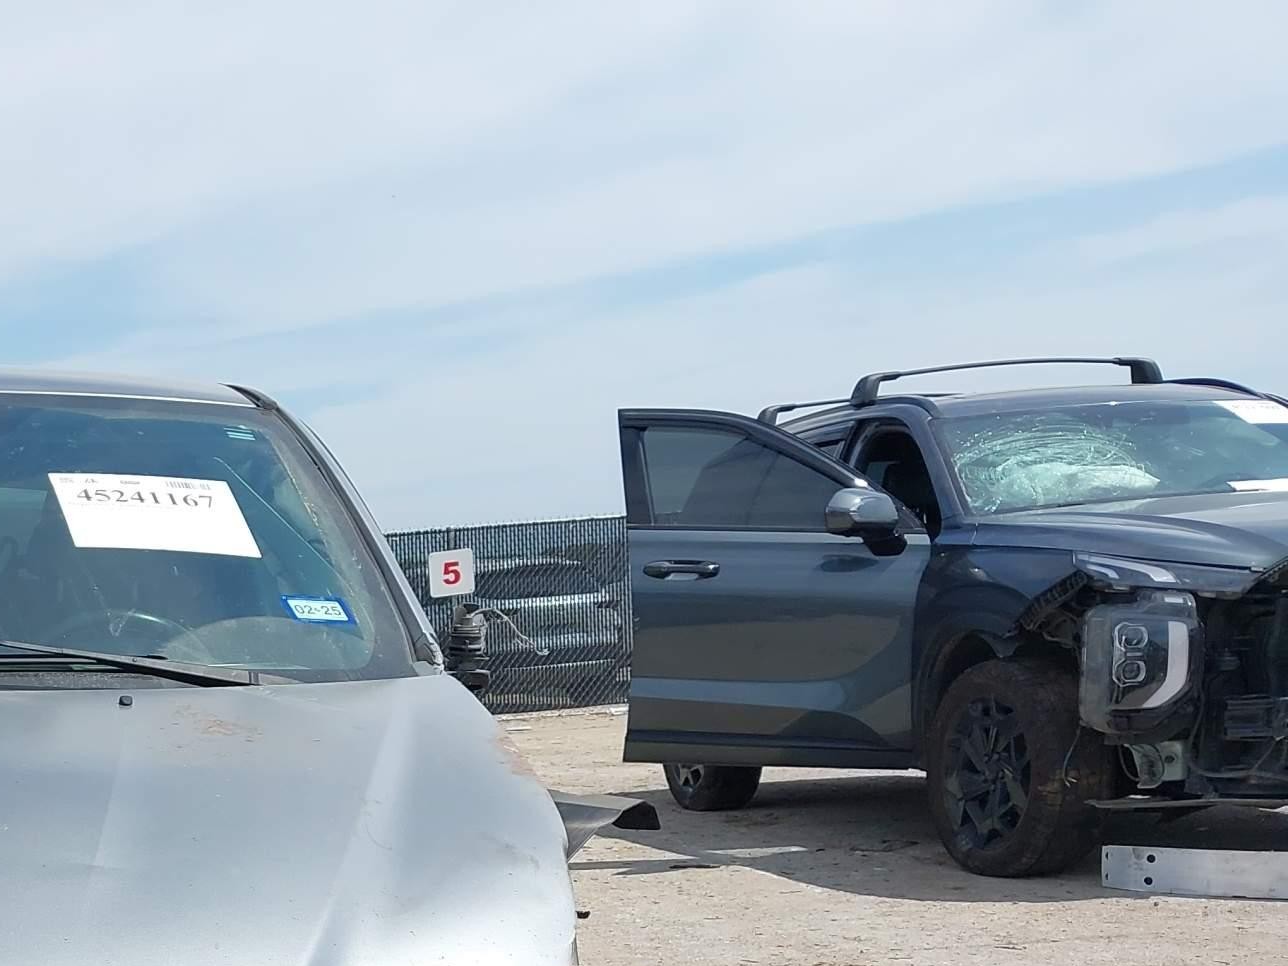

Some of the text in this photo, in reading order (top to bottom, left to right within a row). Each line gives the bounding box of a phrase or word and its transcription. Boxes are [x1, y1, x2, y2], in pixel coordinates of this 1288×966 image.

[76, 487, 213, 509] 45241167
[442, 561, 461, 585] 5
[294, 604, 342, 616] 02-25
